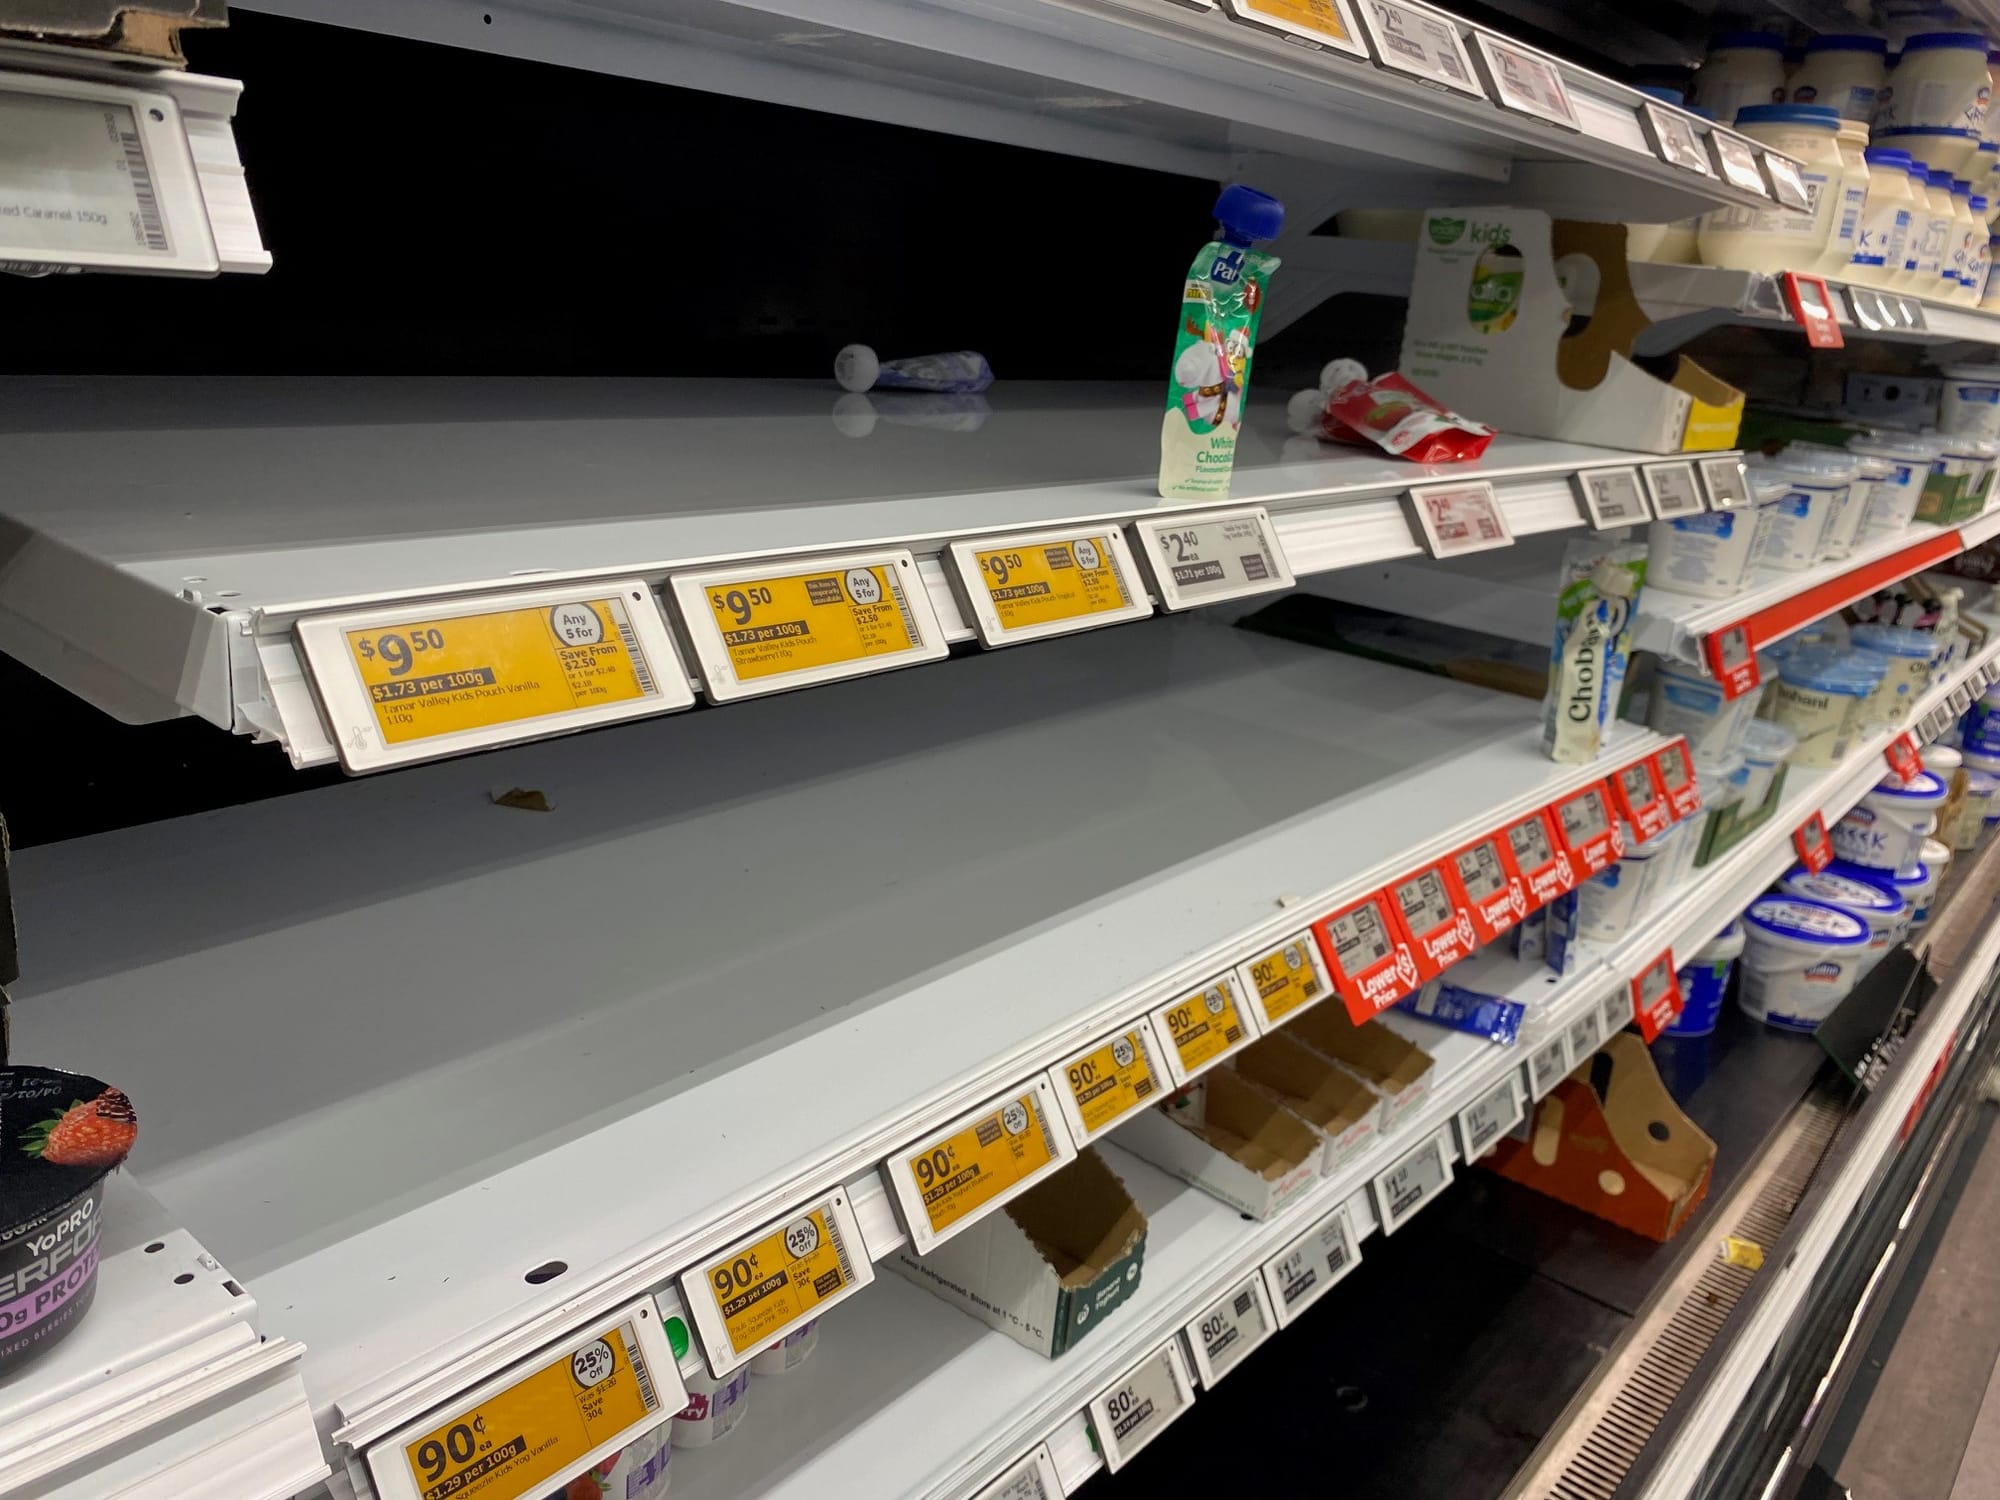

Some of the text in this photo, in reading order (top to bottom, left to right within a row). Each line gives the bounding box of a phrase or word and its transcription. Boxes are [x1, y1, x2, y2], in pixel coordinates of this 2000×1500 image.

[1470, 222, 1511, 243] kids
[853, 578, 870, 588] Any
[856, 589, 874, 598] 5 for
[992, 584, 1046, 601] $1.73 per 100g
[562, 614, 587, 626] Any
[853, 604, 893, 616] Save From
[856, 614, 879, 625] $2.50
[566, 628, 593, 639] 5 for
[725, 623, 801, 645] $1.73 per 100g
[560, 645, 618, 661] Save From
[564, 656, 597, 671] $2.50
[372, 671, 485, 701] $1.73 per 100g
[382, 680, 541, 714] Tamar Valley Kids Pouch Vanilla
[386, 714, 414, 726] 110g
[1528, 867, 1558, 895] Lower
[1479, 895, 1512, 925] Lower
[1492, 915, 1513, 934] Price
[1422, 927, 1458, 960] Lower
[1436, 949, 1459, 968] Price
[1356, 964, 1398, 1000] Lower
[1372, 987, 1398, 1010] Price
[1004, 1105, 1025, 1125] 25%
[917, 1144, 955, 1188] 90¢
[924, 1167, 975, 1204] $1.29 per 100g
[789, 1224, 816, 1249] 25%
[798, 1239, 812, 1252] Off
[715, 1252, 764, 1300] 90¢ ea
[793, 1267, 811, 1281] Save
[900, 1254, 919, 1270] Keep
[920, 1264, 969, 1297] Refrigerated.
[970, 1292, 991, 1311] Store
[723, 1276, 782, 1316] $1.29 per 100g
[575, 1344, 609, 1375] 25%
[589, 1365, 604, 1378] Off
[582, 1397, 603, 1413] Save
[1108, 1385, 1134, 1421] 80¢
[585, 1407, 603, 1421] 30¢
[417, 1414, 493, 1483] 90¢ ea
[495, 1464, 514, 1479] Kids
[513, 1454, 531, 1468] Yog
[530, 1435, 560, 1458] Vanilla
[425, 1443, 518, 1500] $1.29 per 100g
